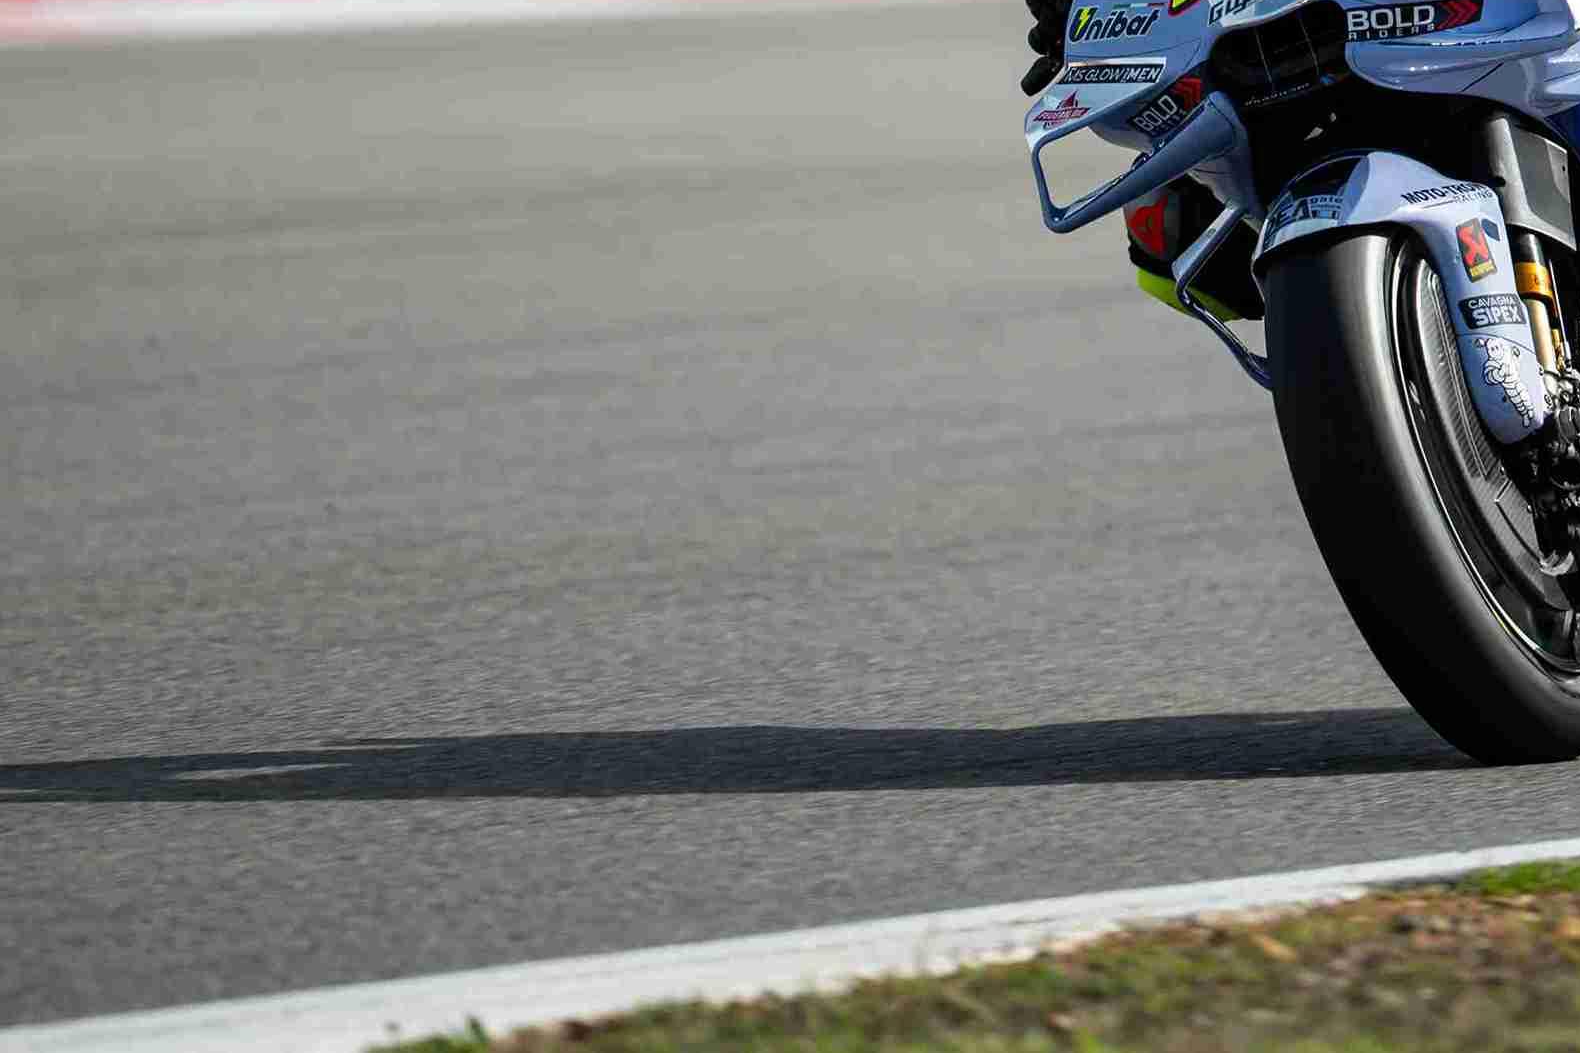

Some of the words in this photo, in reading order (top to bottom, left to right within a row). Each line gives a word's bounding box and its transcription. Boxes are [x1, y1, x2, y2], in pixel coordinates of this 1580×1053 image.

[1068, 6, 1162, 44] Unibat
[1347, 5, 1436, 33] BOLD
[1134, 94, 1178, 133] BOLD
[1475, 307, 1524, 327] SIPEX
